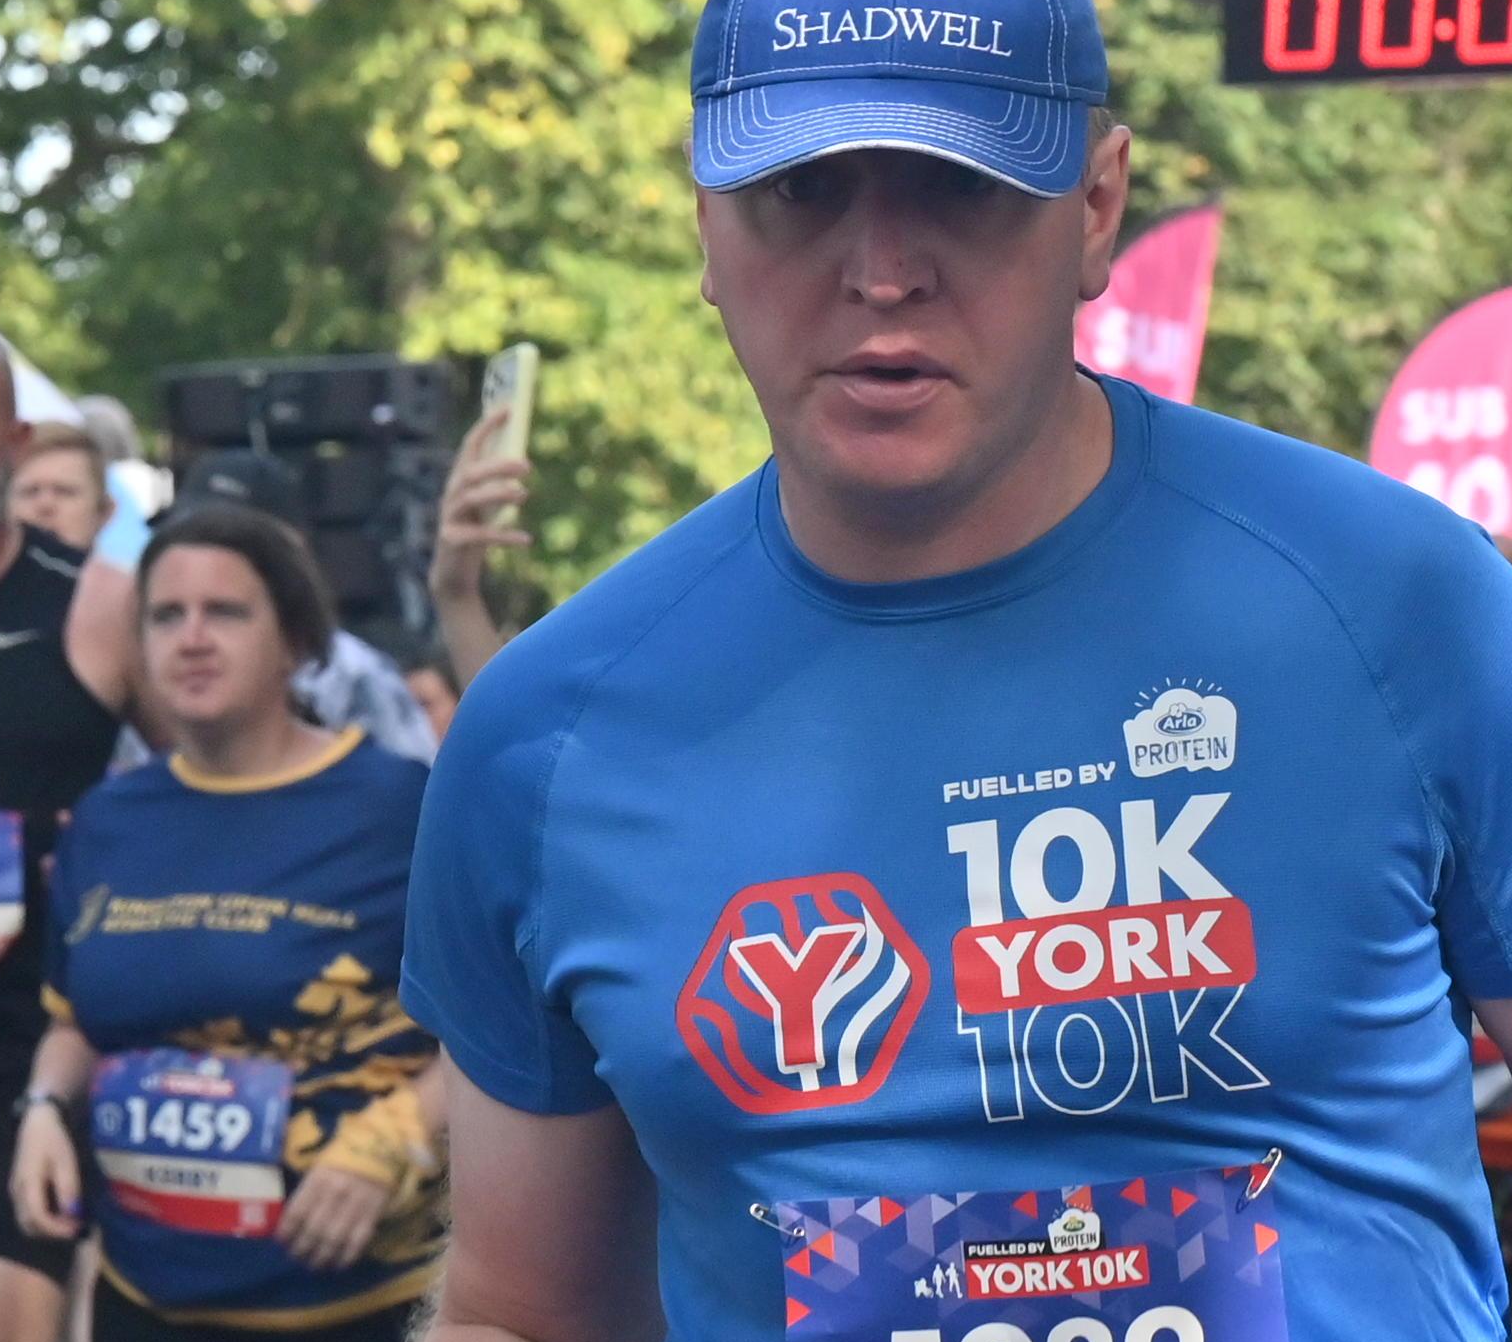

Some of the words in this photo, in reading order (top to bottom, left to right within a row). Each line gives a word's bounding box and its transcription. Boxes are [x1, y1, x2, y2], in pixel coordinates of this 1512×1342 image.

[772, 7, 1013, 58] SHADWELL
[1399, 386, 1508, 446] SUB
[1163, 714, 1198, 732] Arla
[1134, 736, 1229, 767] PROTEIN
[943, 768, 1073, 803] FUELLED
[1078, 761, 1116, 785] BY
[946, 792, 1233, 927] 10K
[976, 909, 1233, 999] YORK
[957, 983, 1270, 1123] 10K
[127, 1096, 253, 1153] 1459
[968, 1242, 1026, 1257] FUELLED
[1028, 1241, 1045, 1254] BY
[1054, 1231, 1098, 1247] PROTEIN
[970, 1259, 1074, 1294] YORK
[1077, 1250, 1143, 1287] 10K
